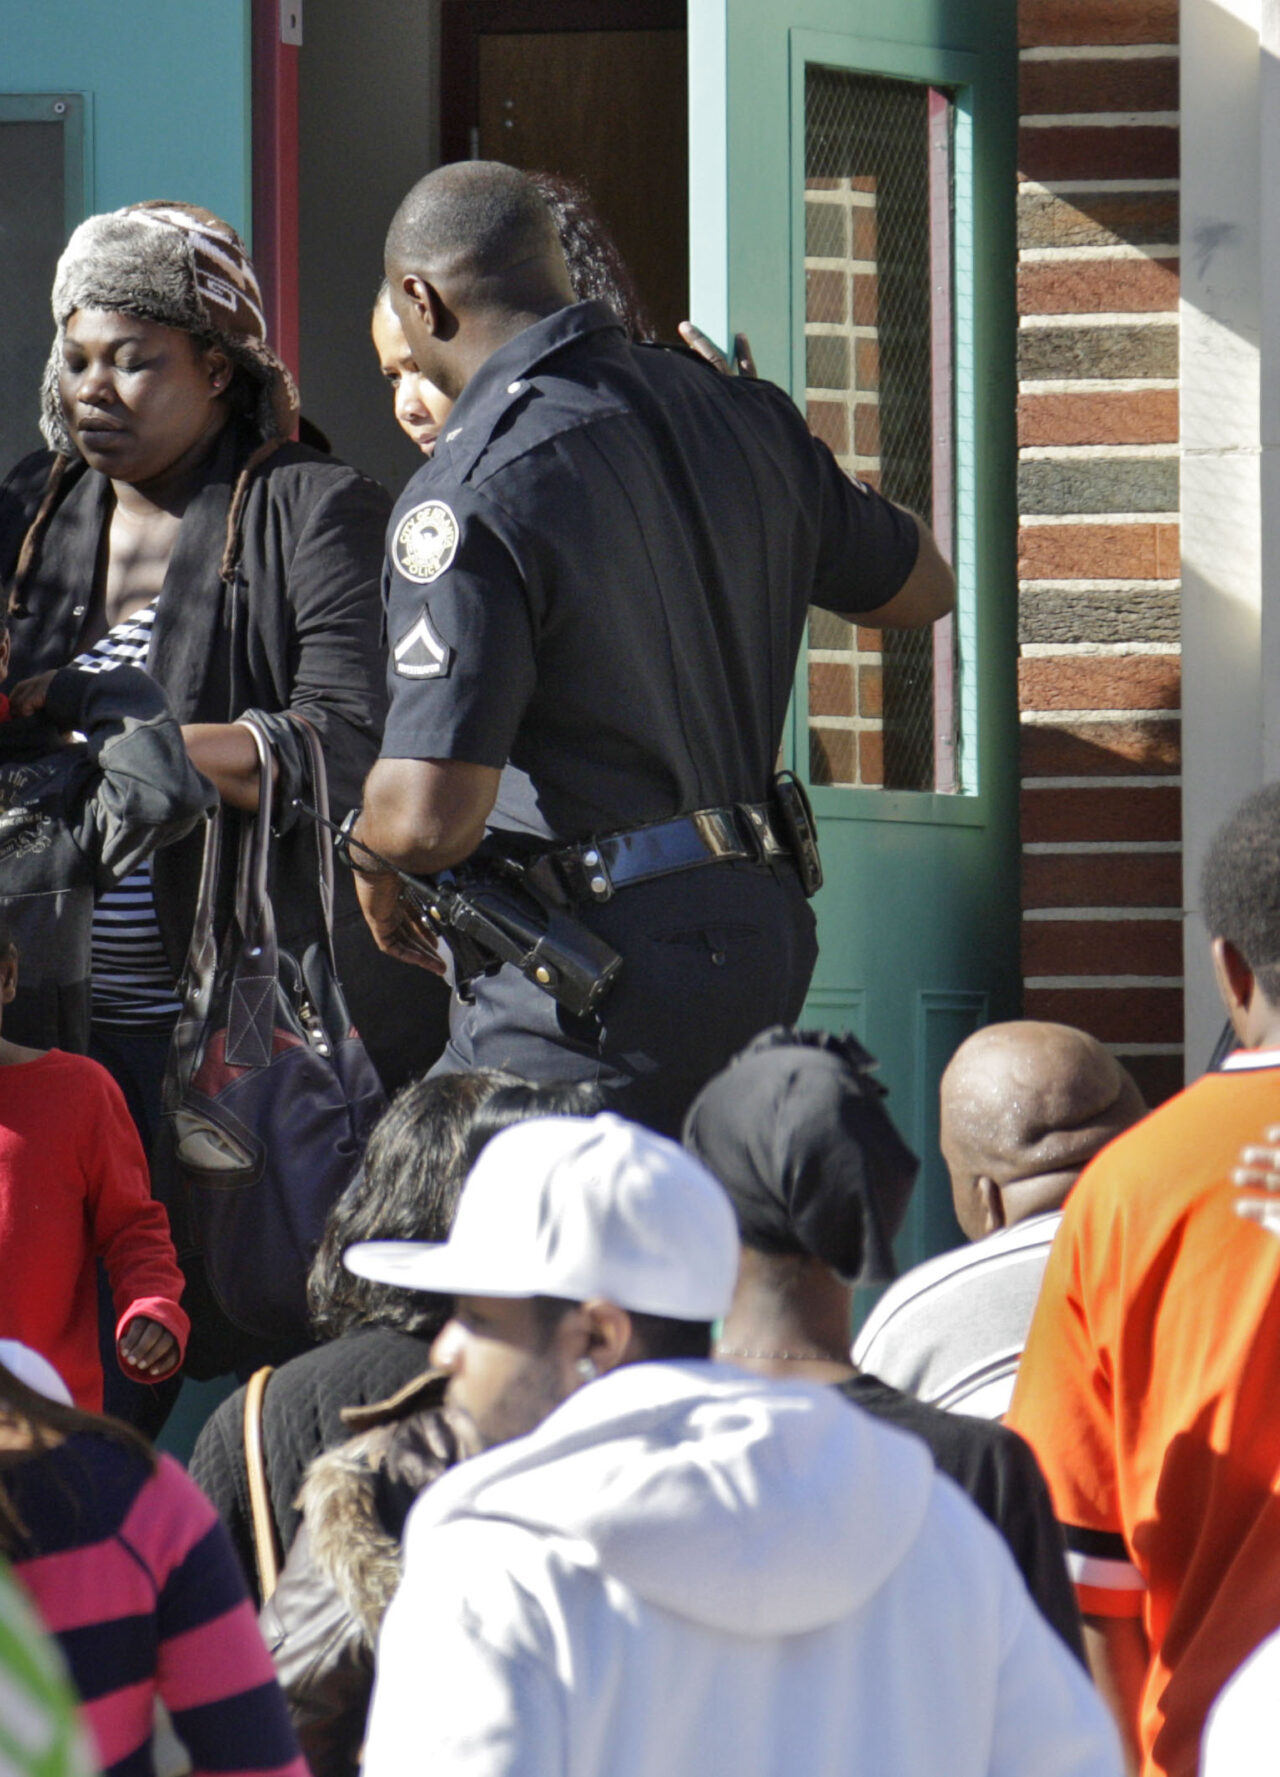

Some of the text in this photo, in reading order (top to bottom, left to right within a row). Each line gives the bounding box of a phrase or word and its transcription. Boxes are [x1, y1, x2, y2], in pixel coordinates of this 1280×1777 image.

[400, 507, 454, 549] CITY OF ATLANTA
[401, 556, 442, 577] POLICE
